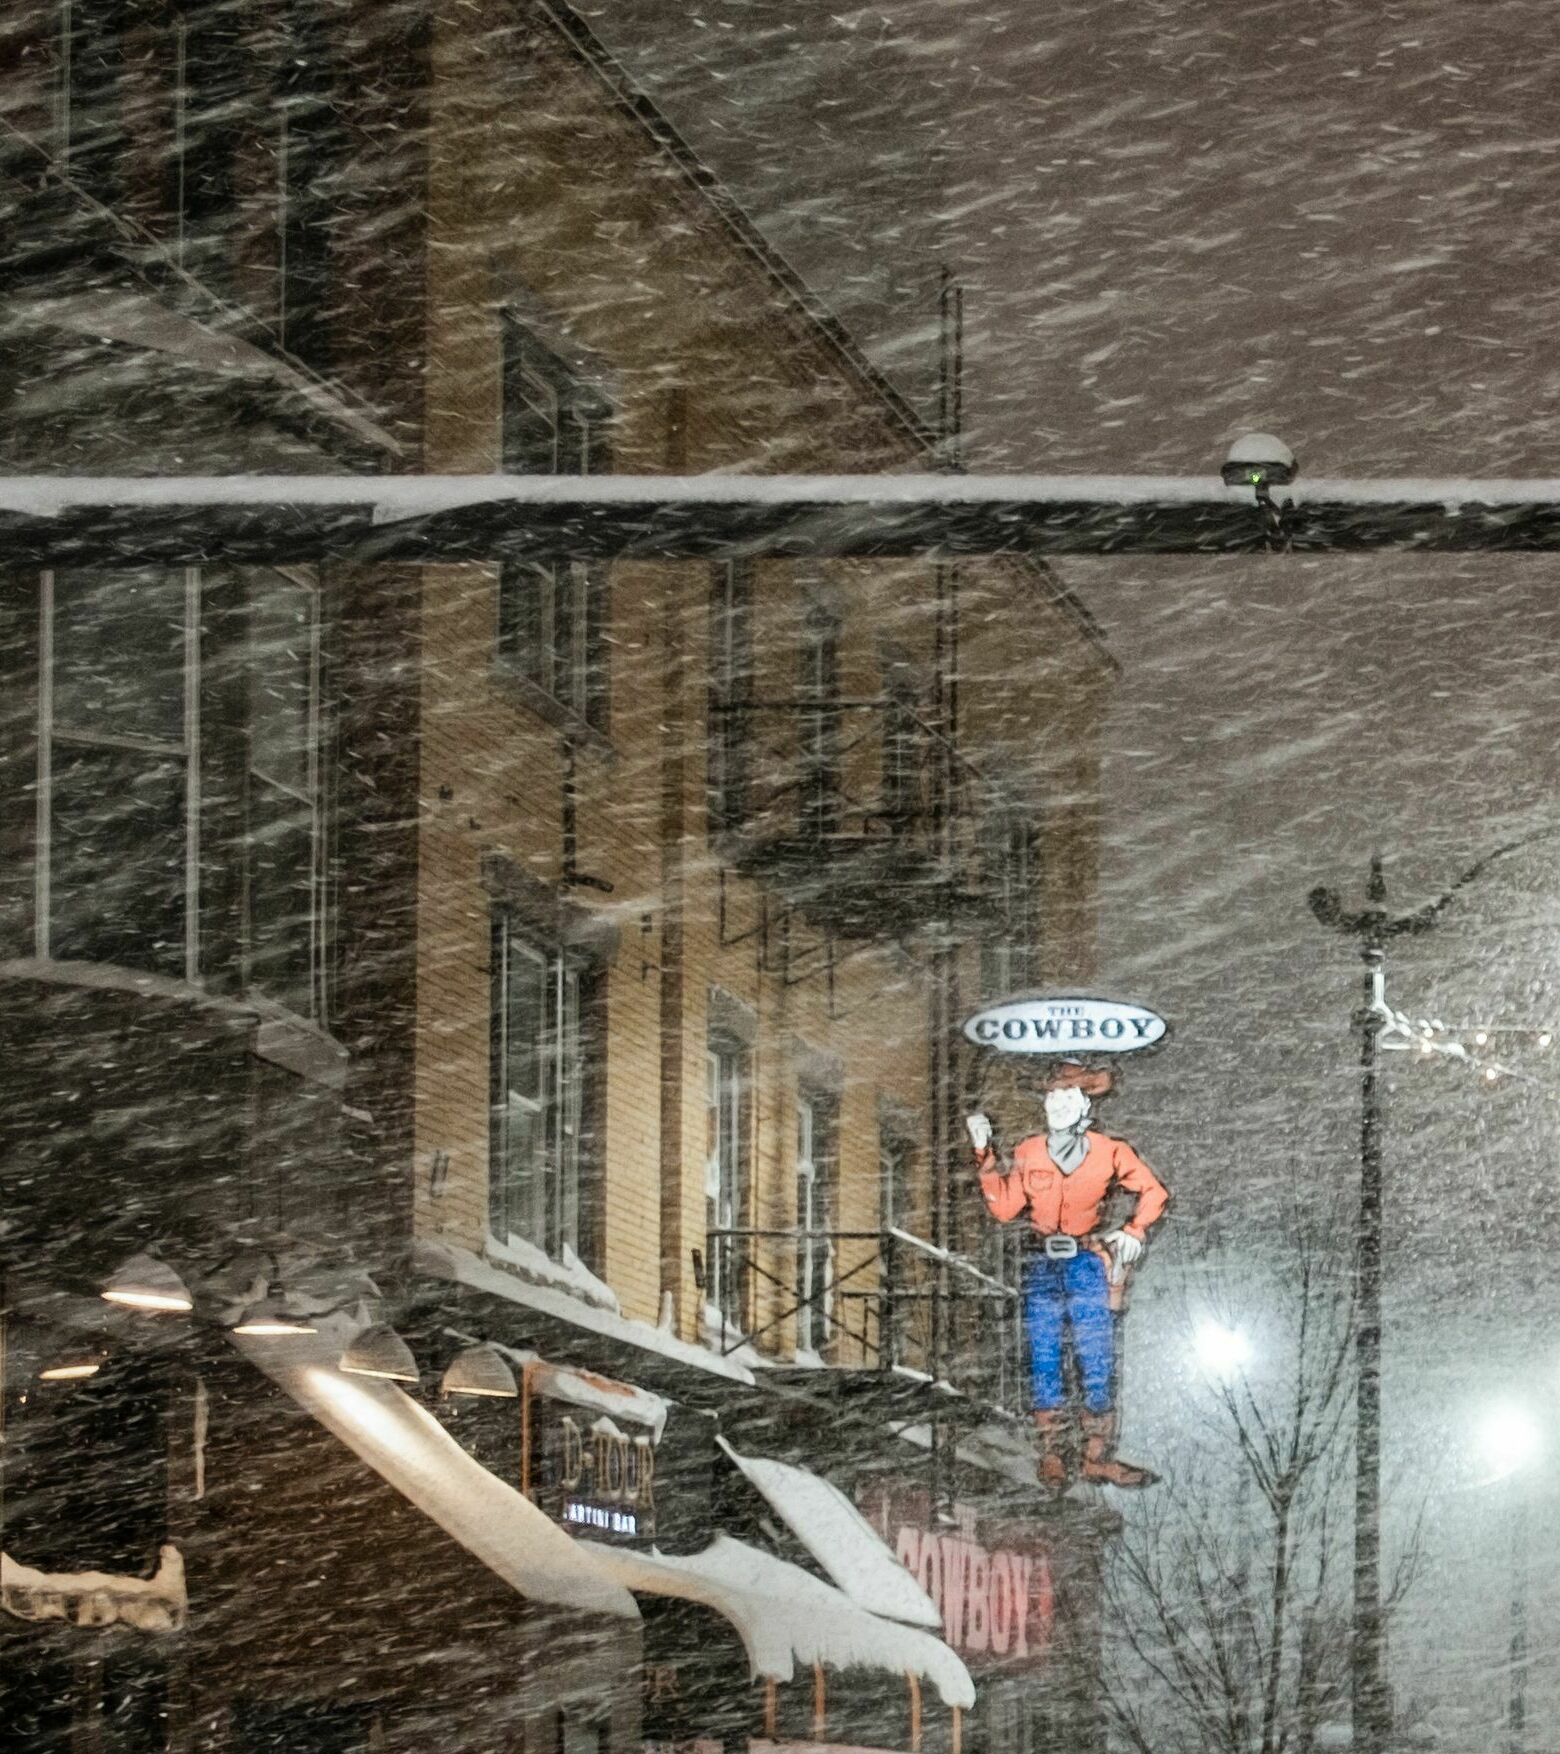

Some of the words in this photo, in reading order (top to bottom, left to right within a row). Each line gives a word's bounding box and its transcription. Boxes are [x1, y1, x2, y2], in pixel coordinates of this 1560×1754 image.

[1047, 1006, 1084, 1017] THE
[975, 1017, 1154, 1040] COWBOY
[562, 1502, 609, 1528] ARTINI
[613, 1512, 637, 1536] BAR
